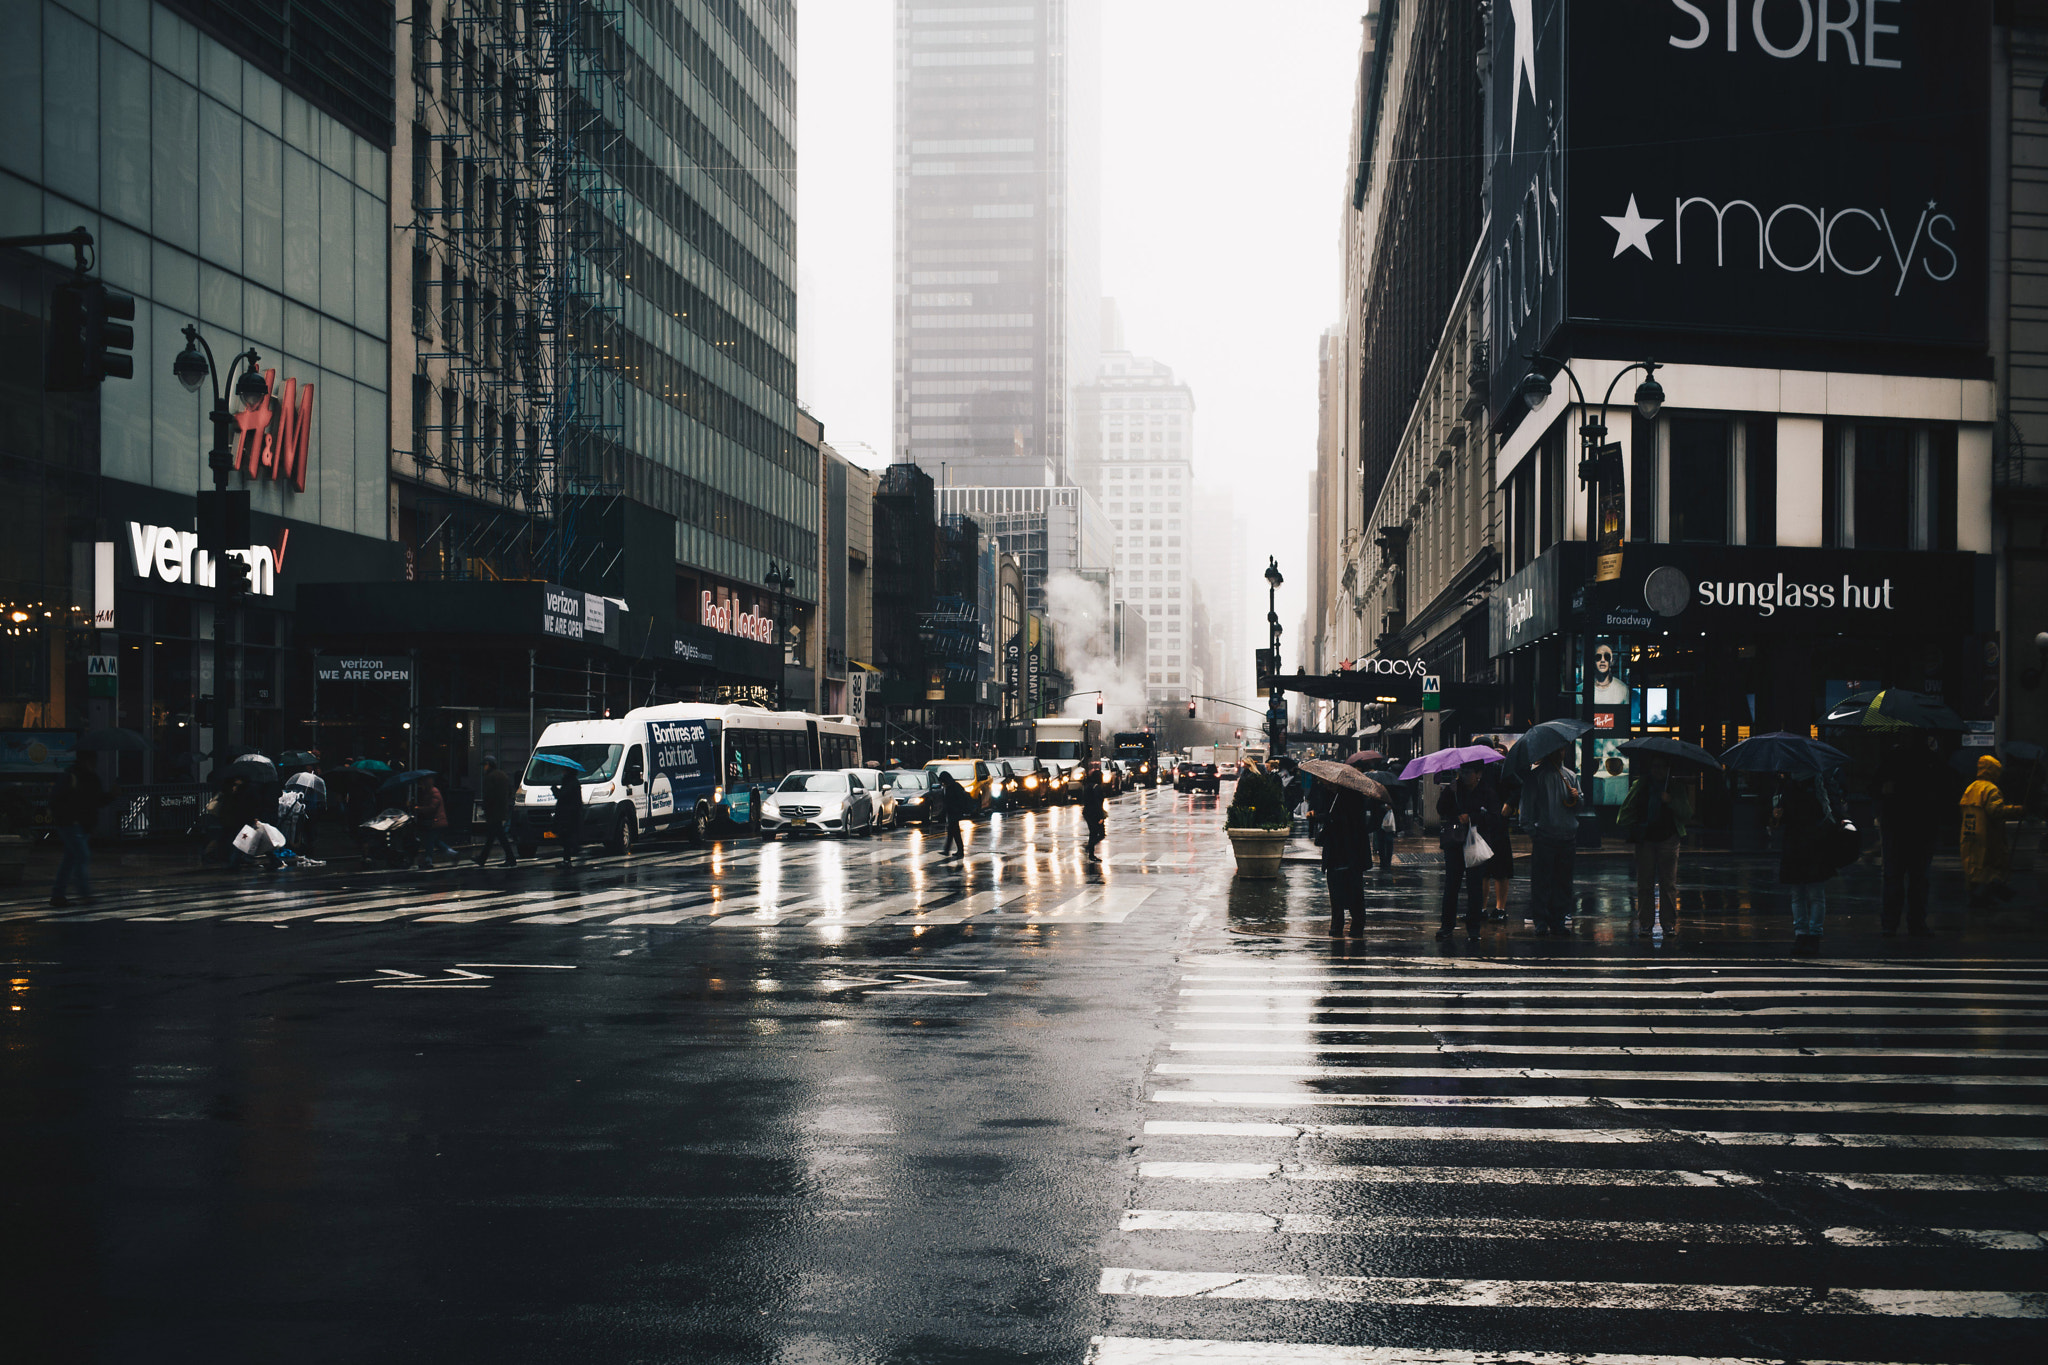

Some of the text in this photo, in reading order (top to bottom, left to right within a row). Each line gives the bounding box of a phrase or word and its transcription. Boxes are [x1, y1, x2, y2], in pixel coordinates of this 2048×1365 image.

[1675, 197, 1957, 296] macy's
[126, 517, 274, 597] verin
[547, 590, 579, 617] verizon
[1698, 573, 1894, 617] sunglass hut
[544, 614, 554, 633] WE
[555, 617, 567, 635] ARE
[568, 620, 583, 639] OPEN
[702, 590, 773, 645] Foot Locker
[1607, 615, 1651, 628] Broadway
[679, 641, 699, 660] Payless
[319, 670, 409, 680] WE ARE OPEN
[340, 658, 383, 669] verizon
[1356, 657, 1427, 680] macy's
[1029, 654, 1039, 702] OLD NAVY
[651, 722, 705, 744] Bonfires are
[658, 744, 698, 767] a bit final.
